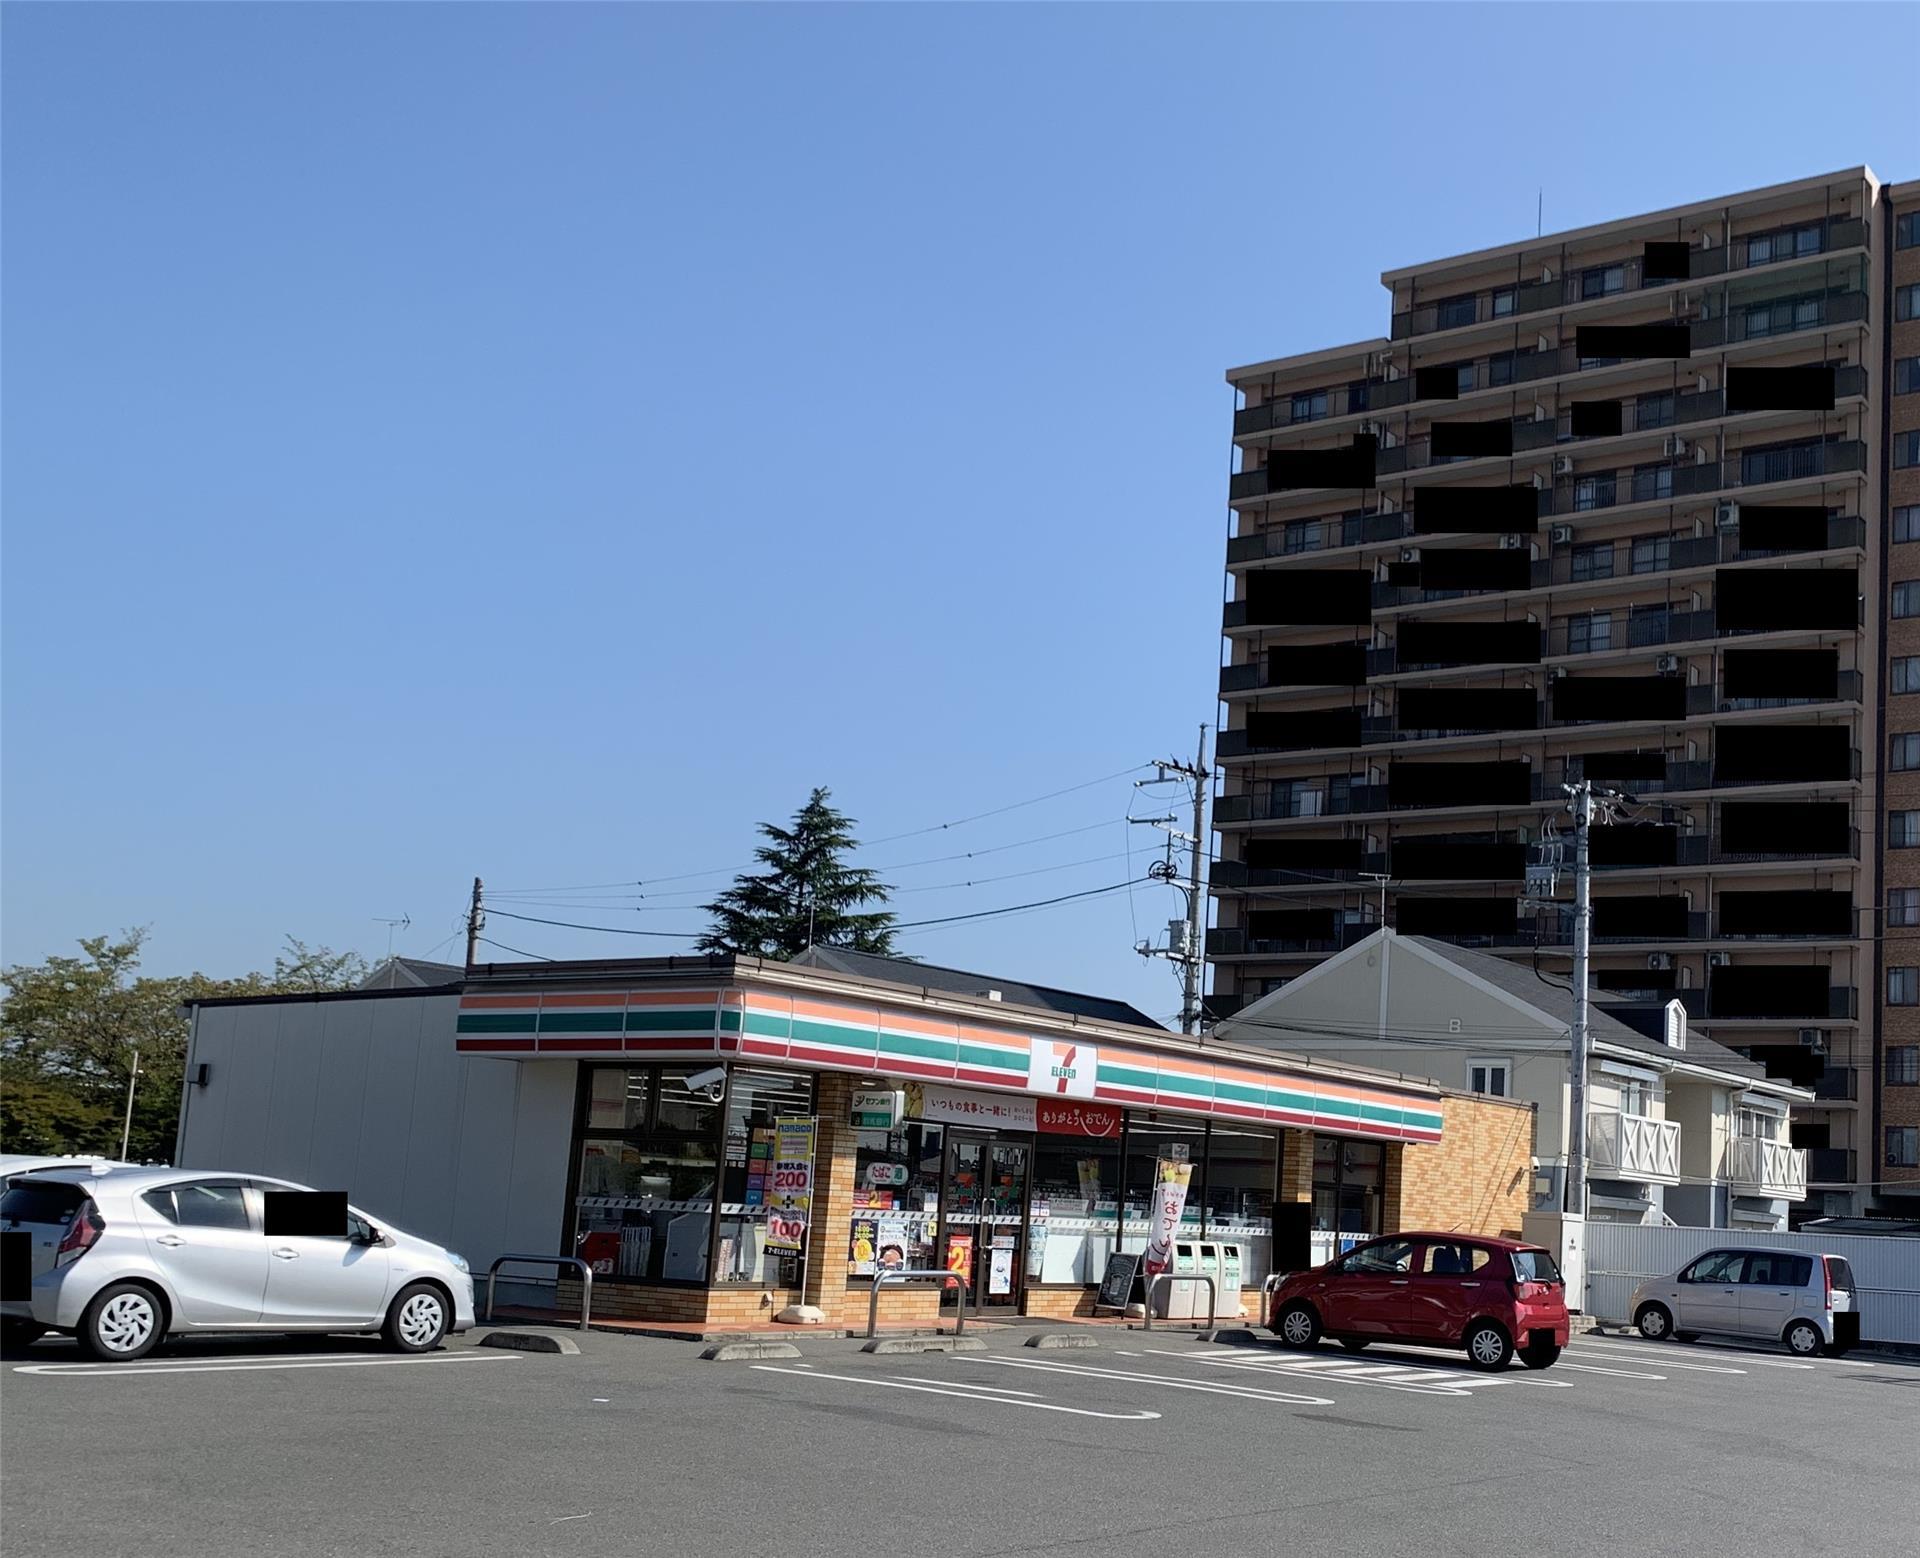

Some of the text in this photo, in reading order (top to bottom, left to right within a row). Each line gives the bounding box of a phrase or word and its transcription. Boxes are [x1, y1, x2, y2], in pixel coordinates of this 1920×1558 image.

[1052, 1043, 1076, 1093] 7
[775, 1171, 807, 1187] 200
[770, 1219, 802, 1238] 100
